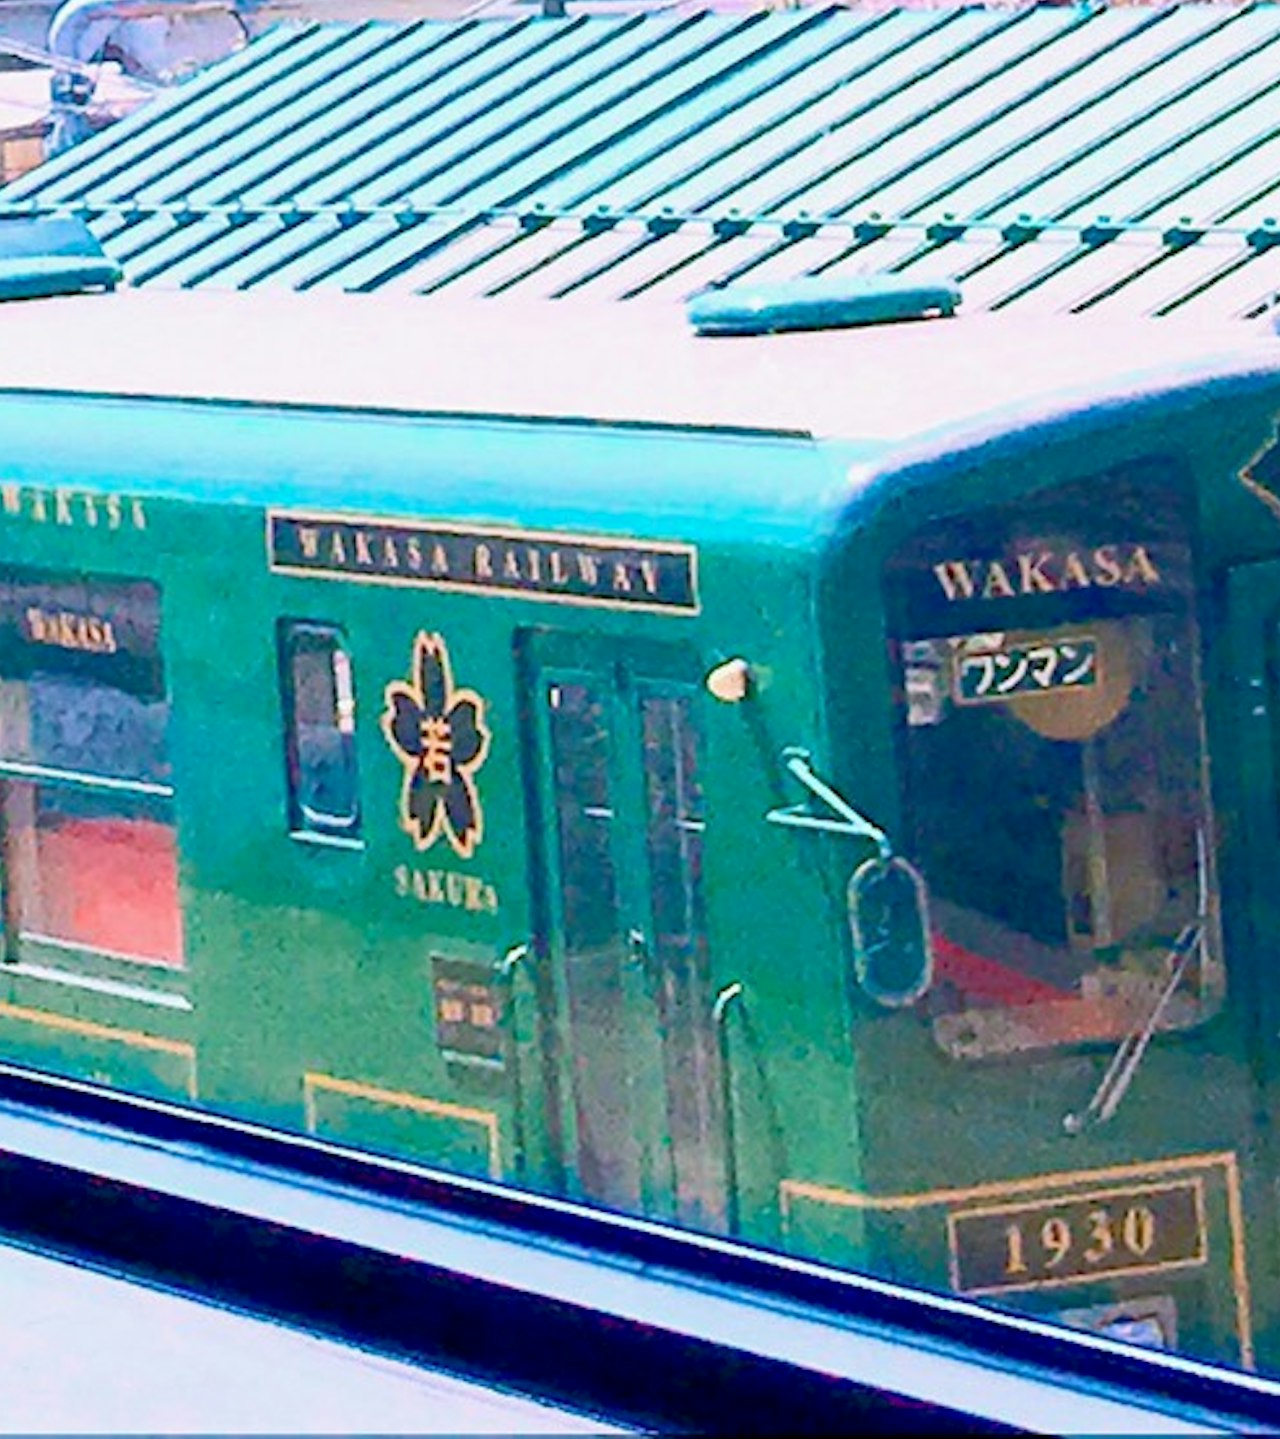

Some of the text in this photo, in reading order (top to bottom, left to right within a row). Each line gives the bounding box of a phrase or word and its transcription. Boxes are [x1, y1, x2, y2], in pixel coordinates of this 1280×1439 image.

[297, 528, 660, 594] WAKASA RAILWAY
[934, 546, 1160, 601] WAKASA
[26, 607, 117, 653] WAKASA
[959, 646, 1094, 695] ワンマン
[394, 864, 499, 915] SAKURA
[1004, 1206, 1155, 1273] 1930
